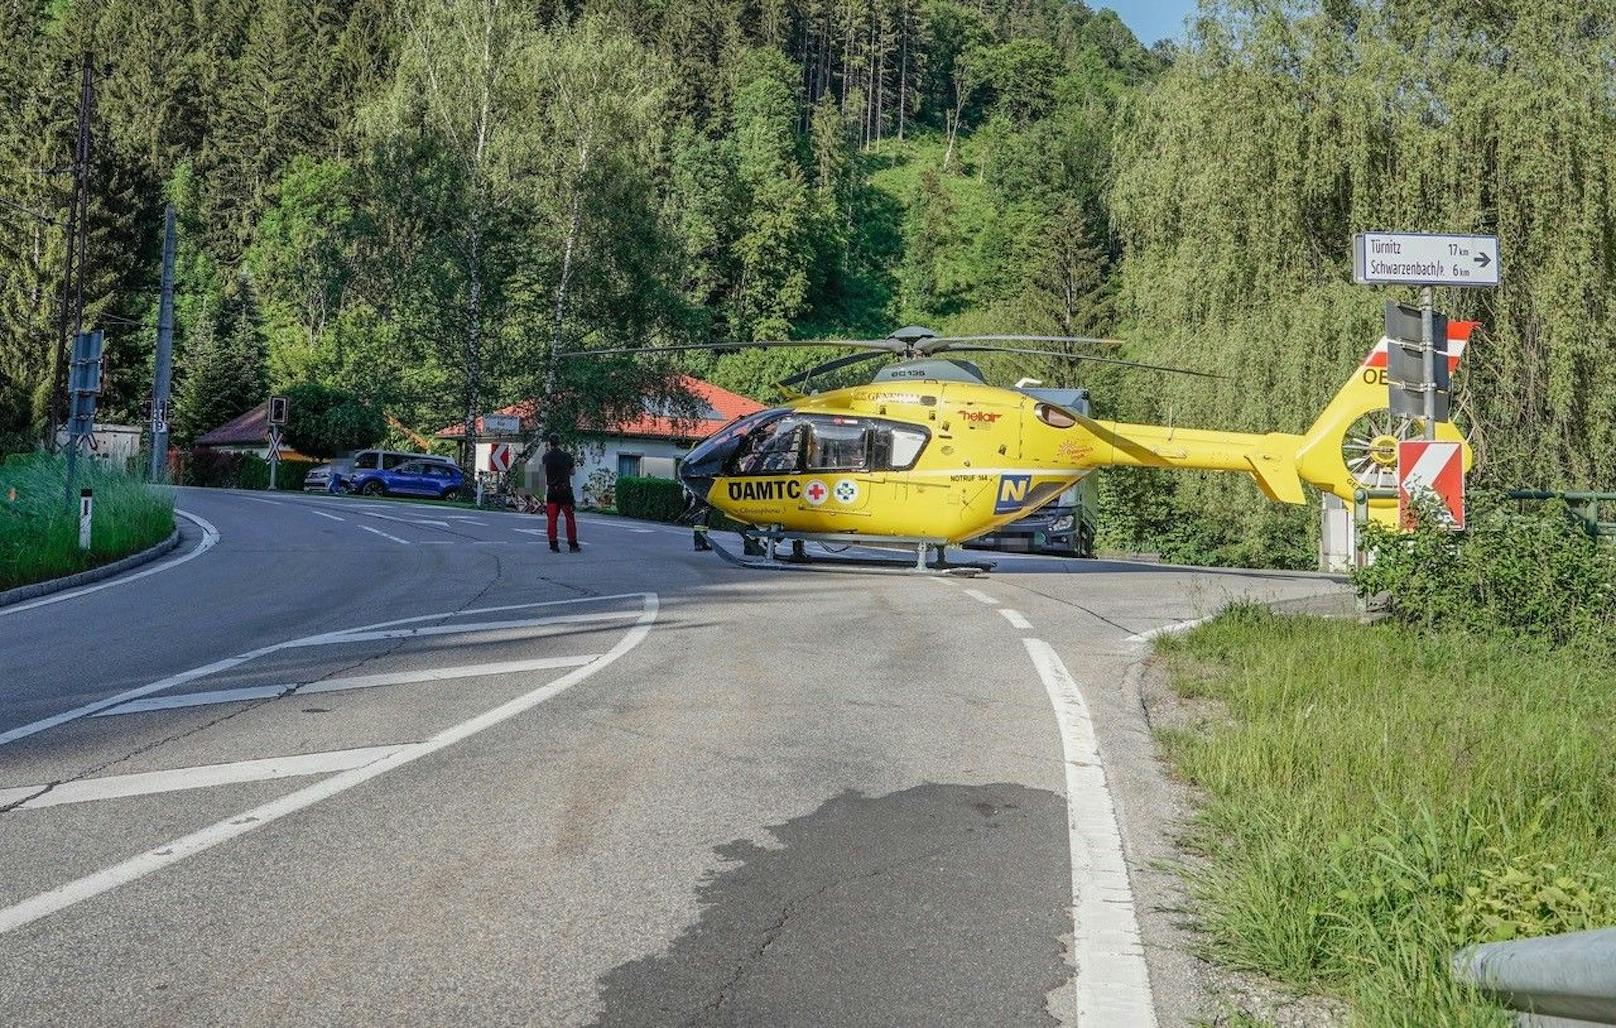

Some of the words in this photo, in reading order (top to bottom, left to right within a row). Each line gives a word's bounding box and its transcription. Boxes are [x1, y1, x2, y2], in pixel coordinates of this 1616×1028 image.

[1370, 239, 1401, 255] Türnitz
[1448, 243, 1458, 256] 17
[1459, 248, 1469, 256] km
[1452, 264, 1459, 277] 6
[1460, 268, 1470, 277] km
[950, 474, 976, 482] NOTRUF
[728, 480, 801, 501] ÖAMTC
[1000, 479, 1028, 502] N
